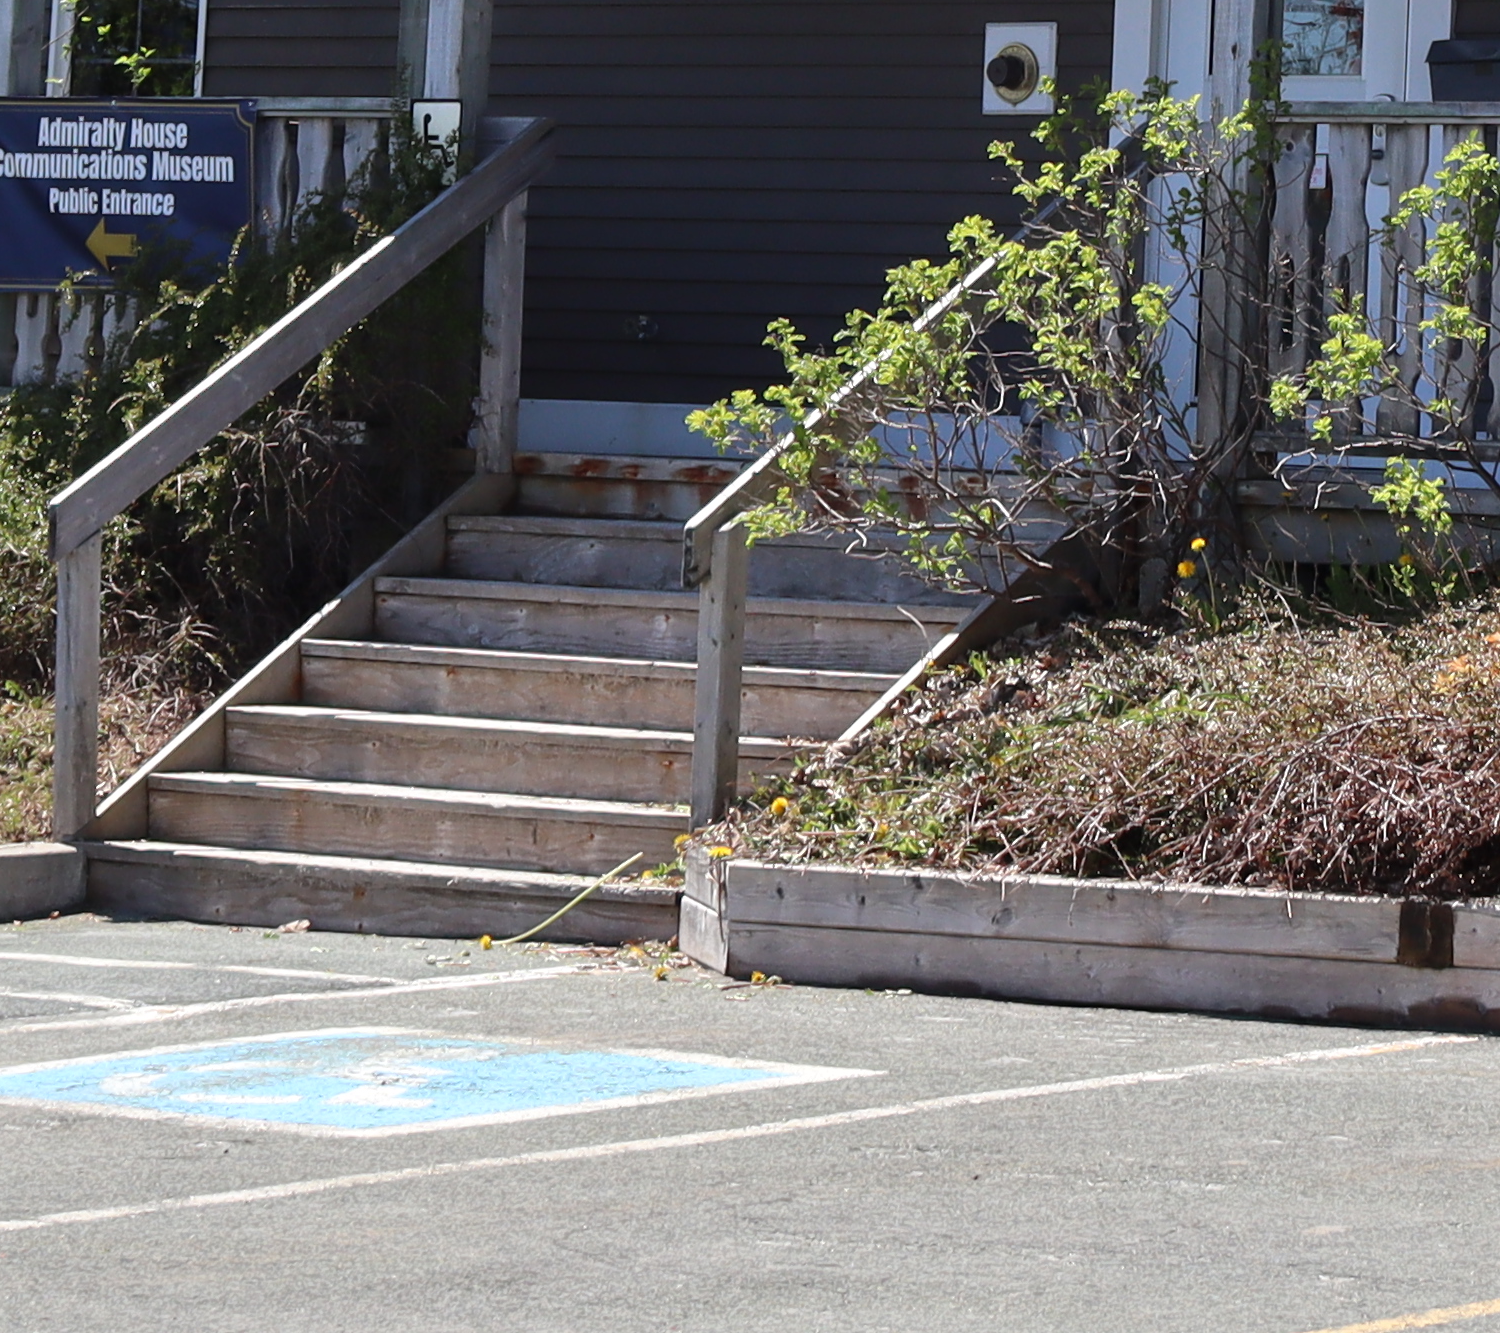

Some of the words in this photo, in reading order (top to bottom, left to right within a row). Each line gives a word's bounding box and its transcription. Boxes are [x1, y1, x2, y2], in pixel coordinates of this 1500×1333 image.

[38, 116, 126, 151] Admiralty
[130, 118, 188, 149] House
[151, 151, 234, 183] Museum
[49, 187, 98, 215] Public
[102, 189, 175, 216] Entrance
